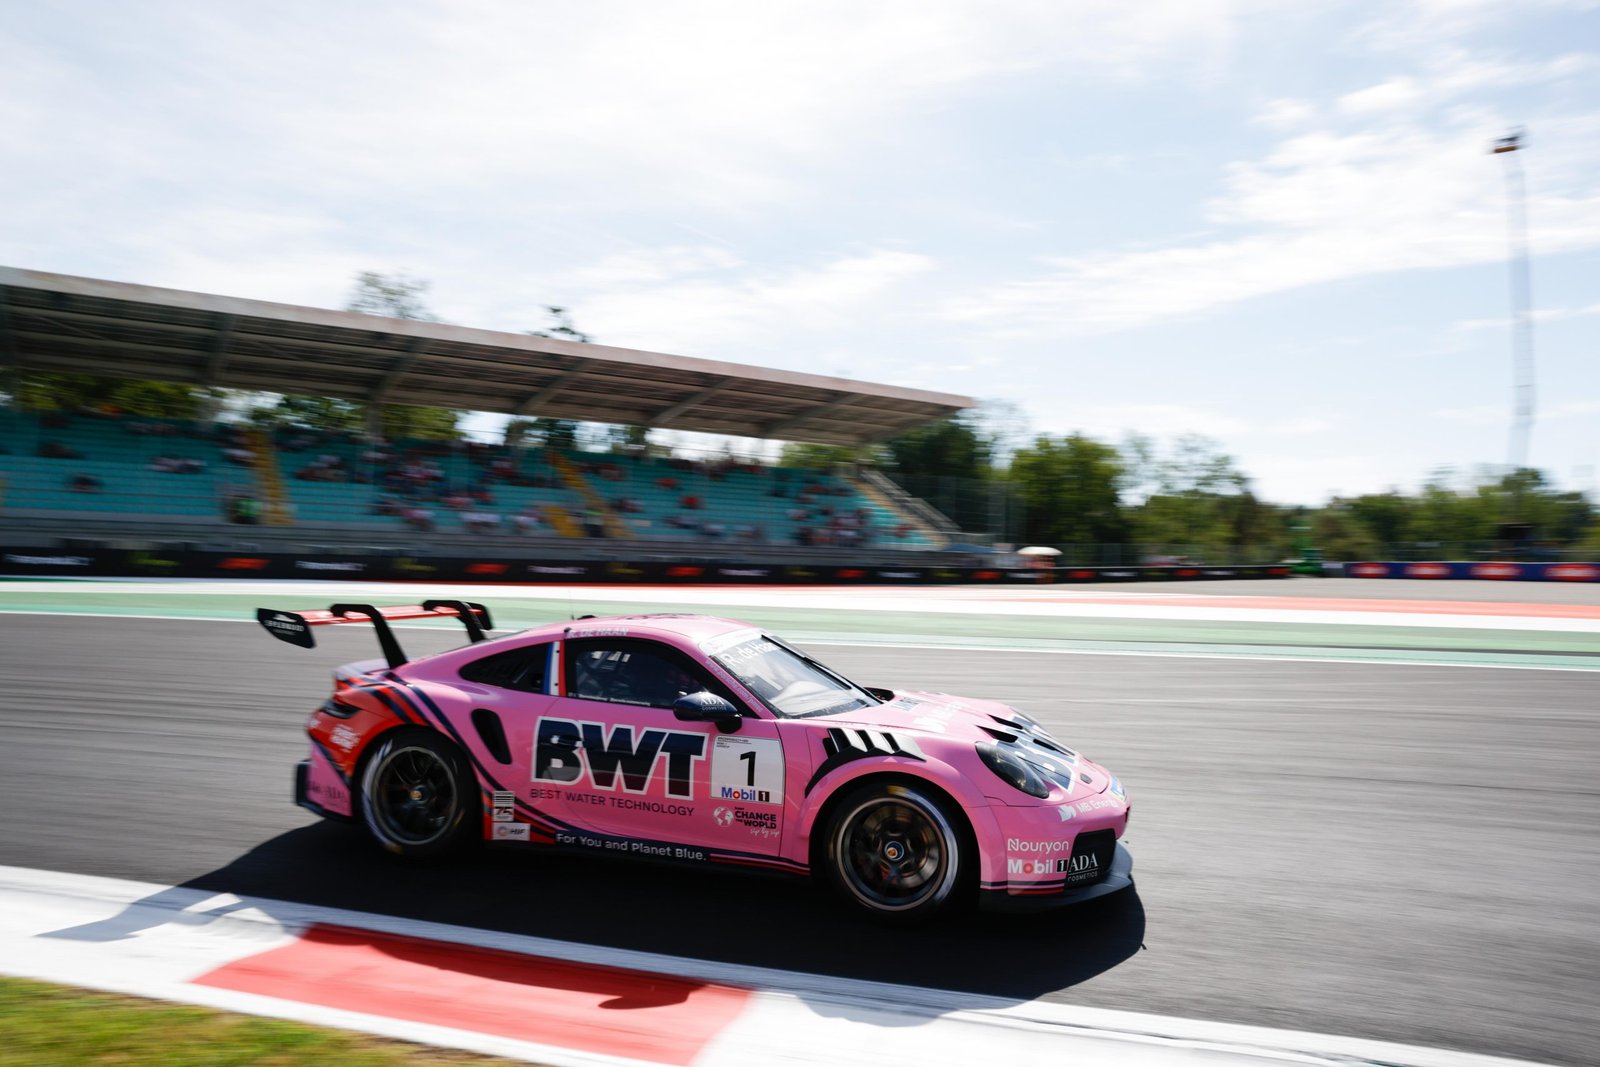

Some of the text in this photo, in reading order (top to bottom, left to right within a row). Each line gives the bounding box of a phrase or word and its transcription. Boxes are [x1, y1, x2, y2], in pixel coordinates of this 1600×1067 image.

[531, 715, 709, 800] BWT
[740, 750, 757, 787] 1
[721, 786, 756, 801] Mobil
[530, 788, 562, 801] BEST
[566, 792, 606, 807] WATER
[609, 798, 695, 817] TECHNOLOGY
[734, 810, 777, 822] CHANGE
[743, 819, 777, 829] WORLD
[556, 833, 708, 860] For You and Planet Blue.
[1007, 838, 1070, 854] Nouryon
[1007, 858, 1054, 874] Mobil
[1070, 852, 1099, 872] ADA
[1068, 870, 1098, 882] COSMETICS
